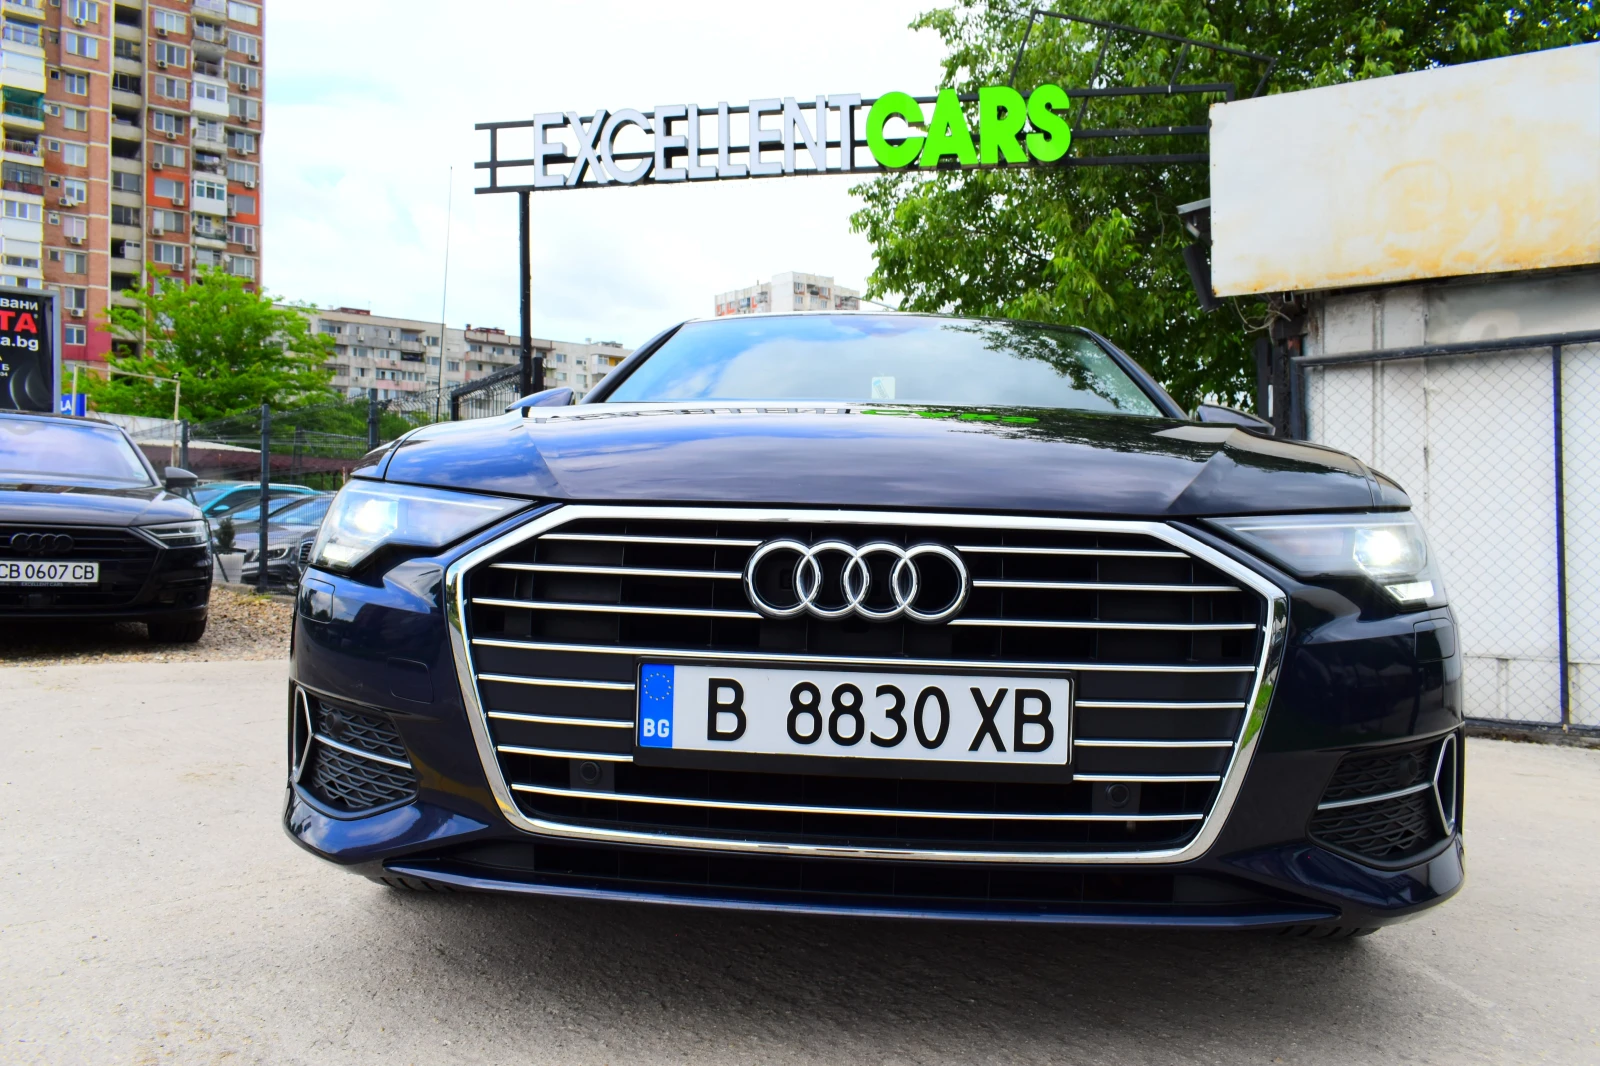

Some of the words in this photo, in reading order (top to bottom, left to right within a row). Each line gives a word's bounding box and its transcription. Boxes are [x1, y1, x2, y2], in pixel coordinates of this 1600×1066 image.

[533, 93, 862, 188] EXCELLENT
[866, 84, 1071, 169] CARS
[0, 563, 20, 579] CB
[25, 564, 68, 579] 0607
[72, 565, 95, 580] CB
[643, 717, 670, 738] BG
[707, 677, 747, 742] B
[786, 681, 950, 750] 8830
[968, 687, 1054, 753] XB
